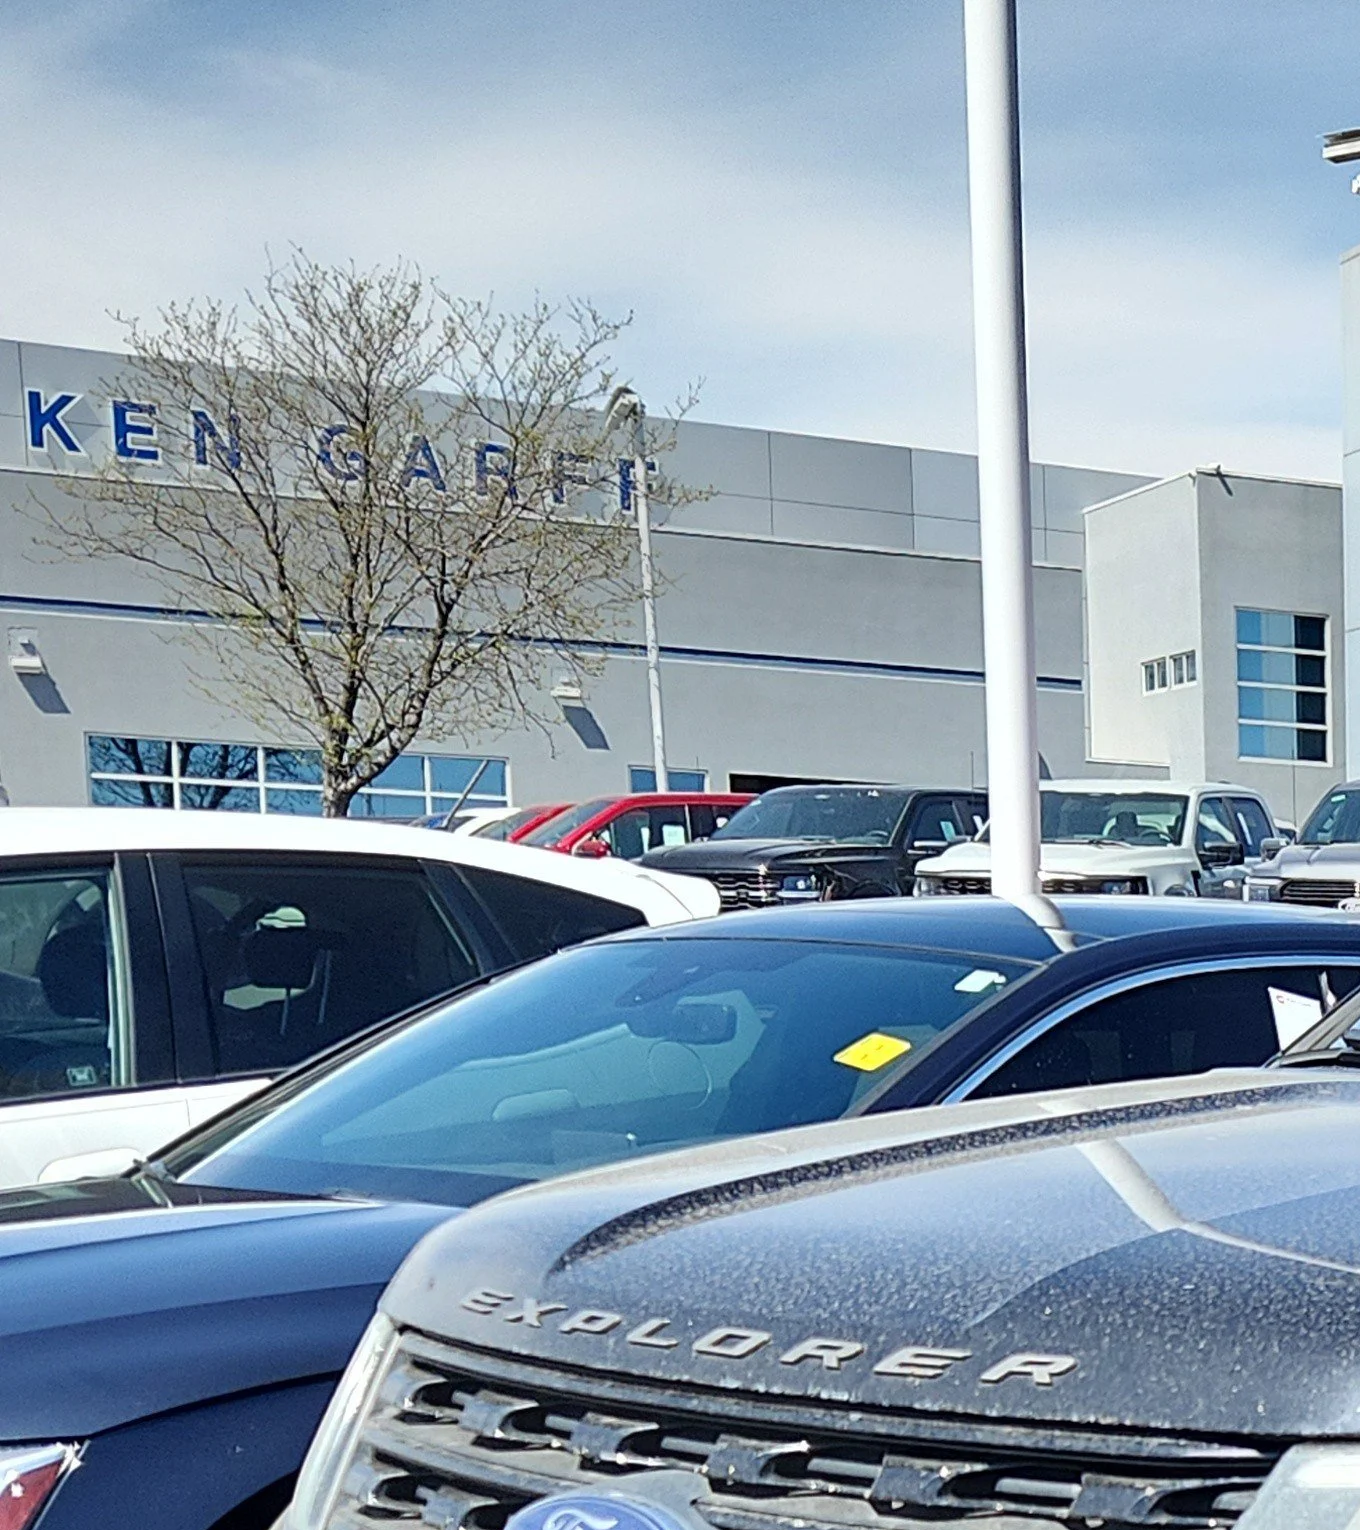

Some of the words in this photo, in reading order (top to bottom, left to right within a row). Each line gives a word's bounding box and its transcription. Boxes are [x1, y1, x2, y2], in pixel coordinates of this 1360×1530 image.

[25, 386, 243, 471] KEN
[317, 422, 662, 512] GARFF
[461, 1288, 1080, 1388] EXPLORER
